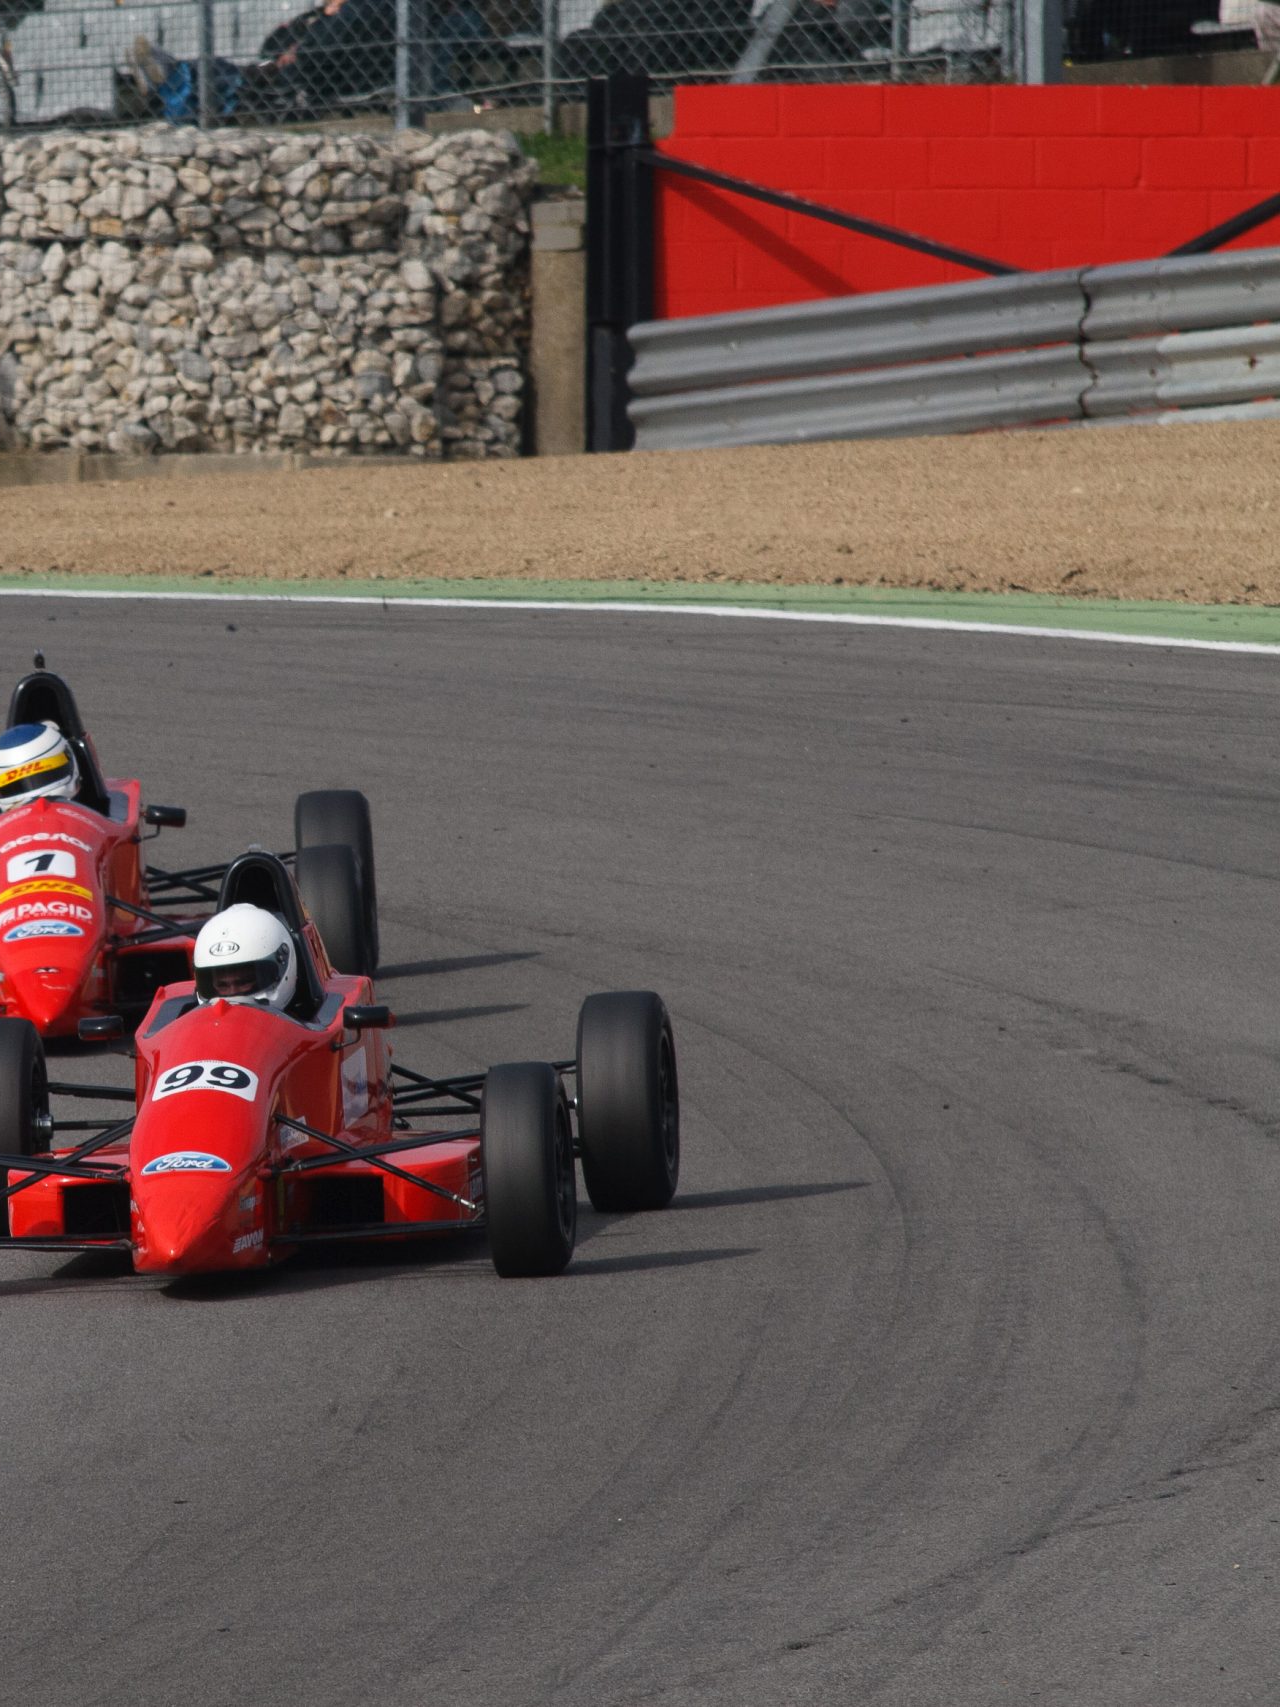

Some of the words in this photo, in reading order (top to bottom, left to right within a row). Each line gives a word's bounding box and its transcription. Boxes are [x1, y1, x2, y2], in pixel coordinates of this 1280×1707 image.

[5, 761, 45, 780] DHL
[24, 853, 56, 872] 1
[17, 901, 93, 919] PAGID
[17, 924, 70, 938] Ford
[160, 1065, 251, 1092] 99
[156, 1156, 215, 1171] Ford
[233, 1228, 264, 1254] AVON
